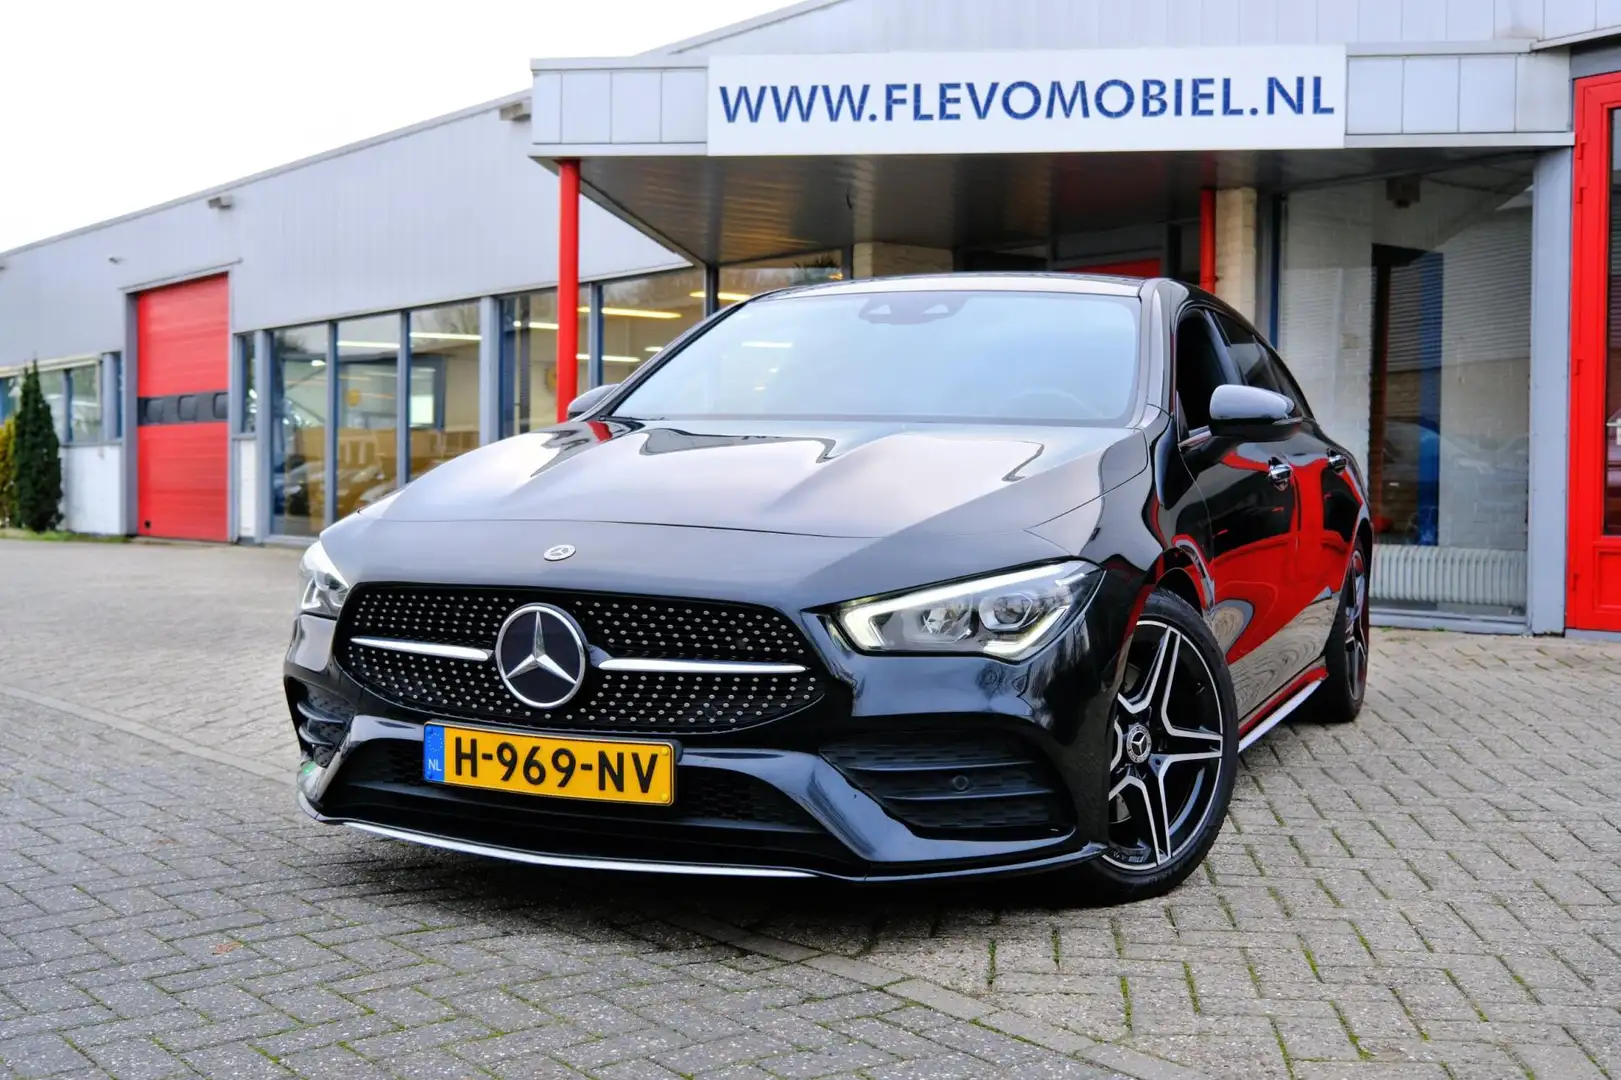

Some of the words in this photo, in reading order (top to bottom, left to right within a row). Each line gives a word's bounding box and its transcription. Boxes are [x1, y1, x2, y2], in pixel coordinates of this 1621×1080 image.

[719, 76, 1335, 123] WWW.FLEVOMOBIEL.NL
[428, 759, 442, 772] NL
[454, 736, 658, 794] H-969-NV
